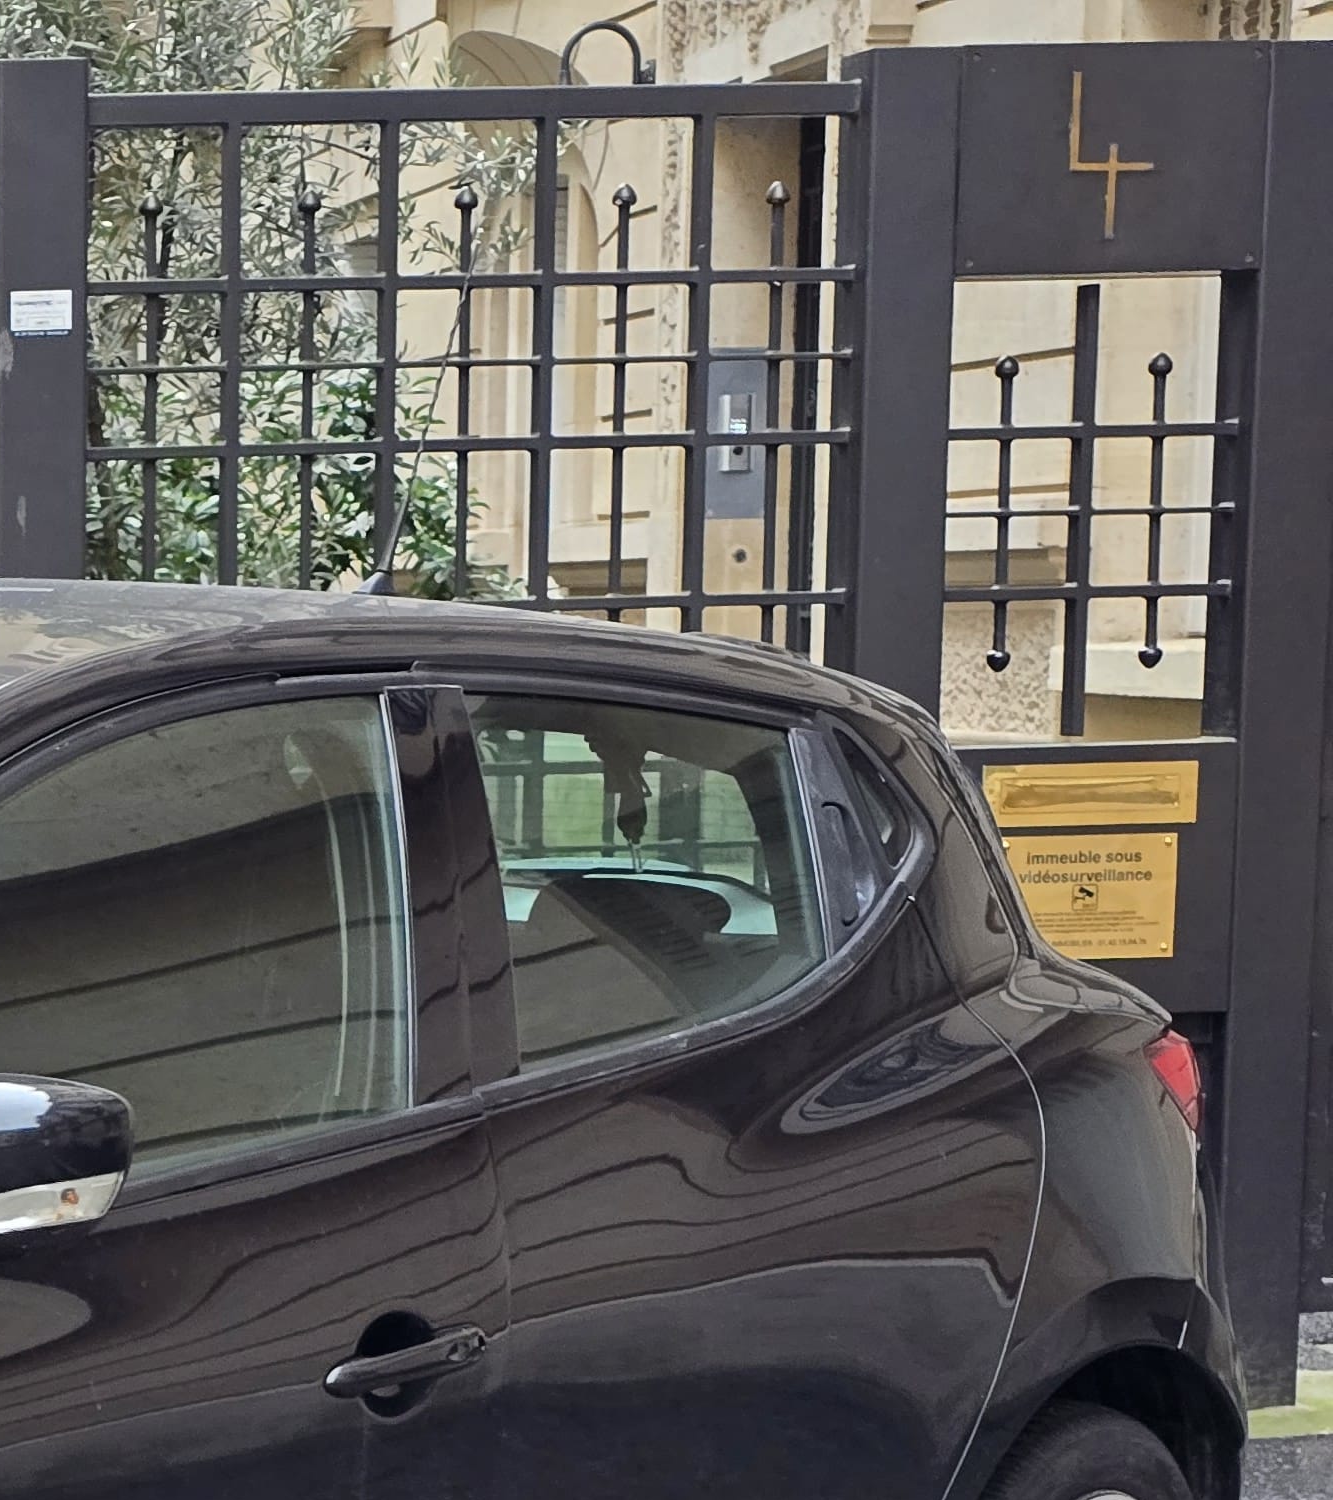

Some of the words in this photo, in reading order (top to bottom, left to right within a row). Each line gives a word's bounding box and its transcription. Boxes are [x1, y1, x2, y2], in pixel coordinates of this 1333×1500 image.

[1068, 70, 1155, 239] 4
[1105, 851, 1143, 863] sous
[1019, 868, 1153, 884] vidéosurveillance
